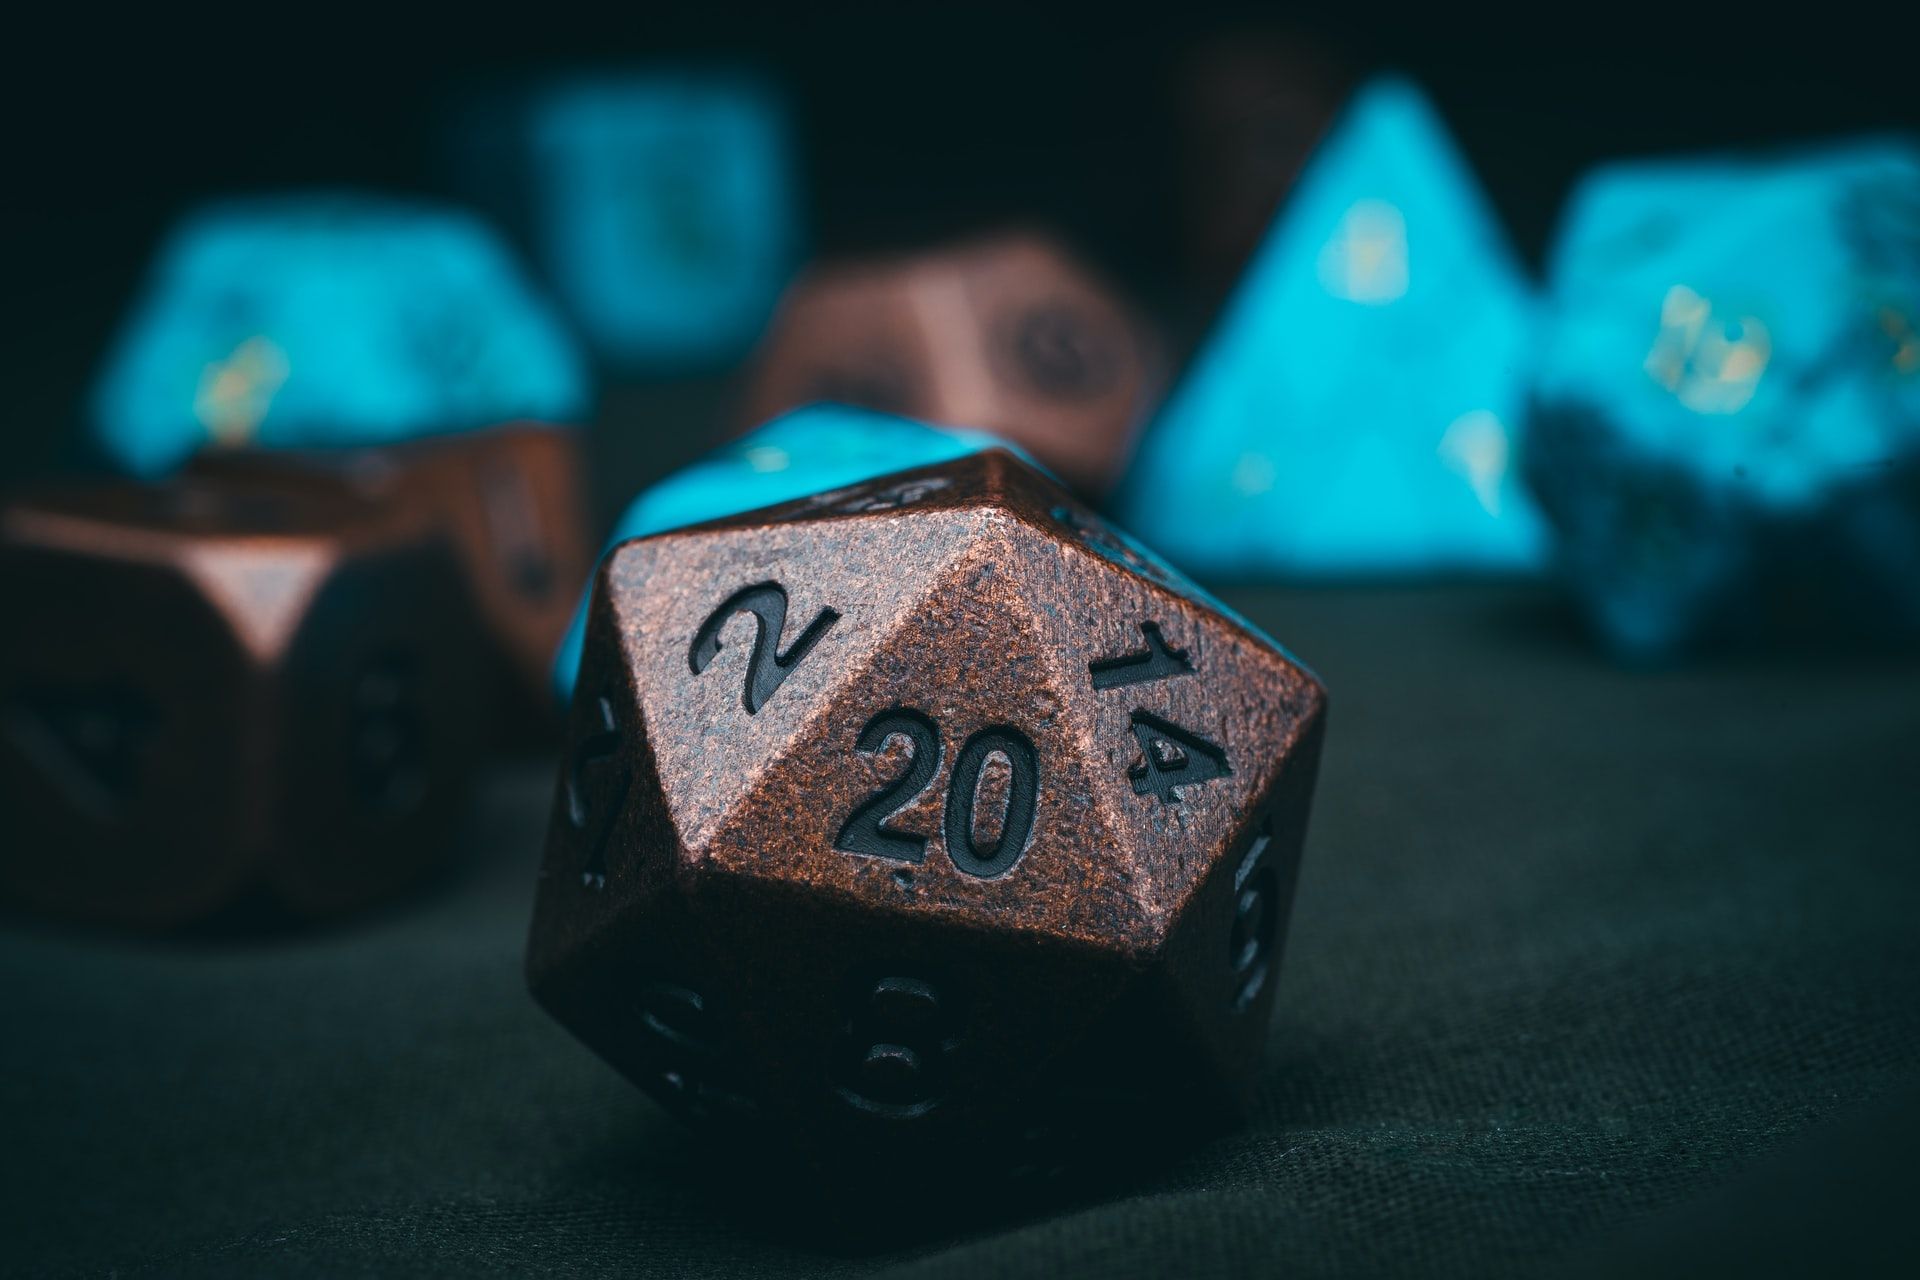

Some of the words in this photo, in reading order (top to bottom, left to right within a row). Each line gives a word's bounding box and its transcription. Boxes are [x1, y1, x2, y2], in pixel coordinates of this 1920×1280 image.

[688, 579, 842, 716] 2
[1089, 620, 1232, 804] 14
[834, 705, 1040, 879] 20
